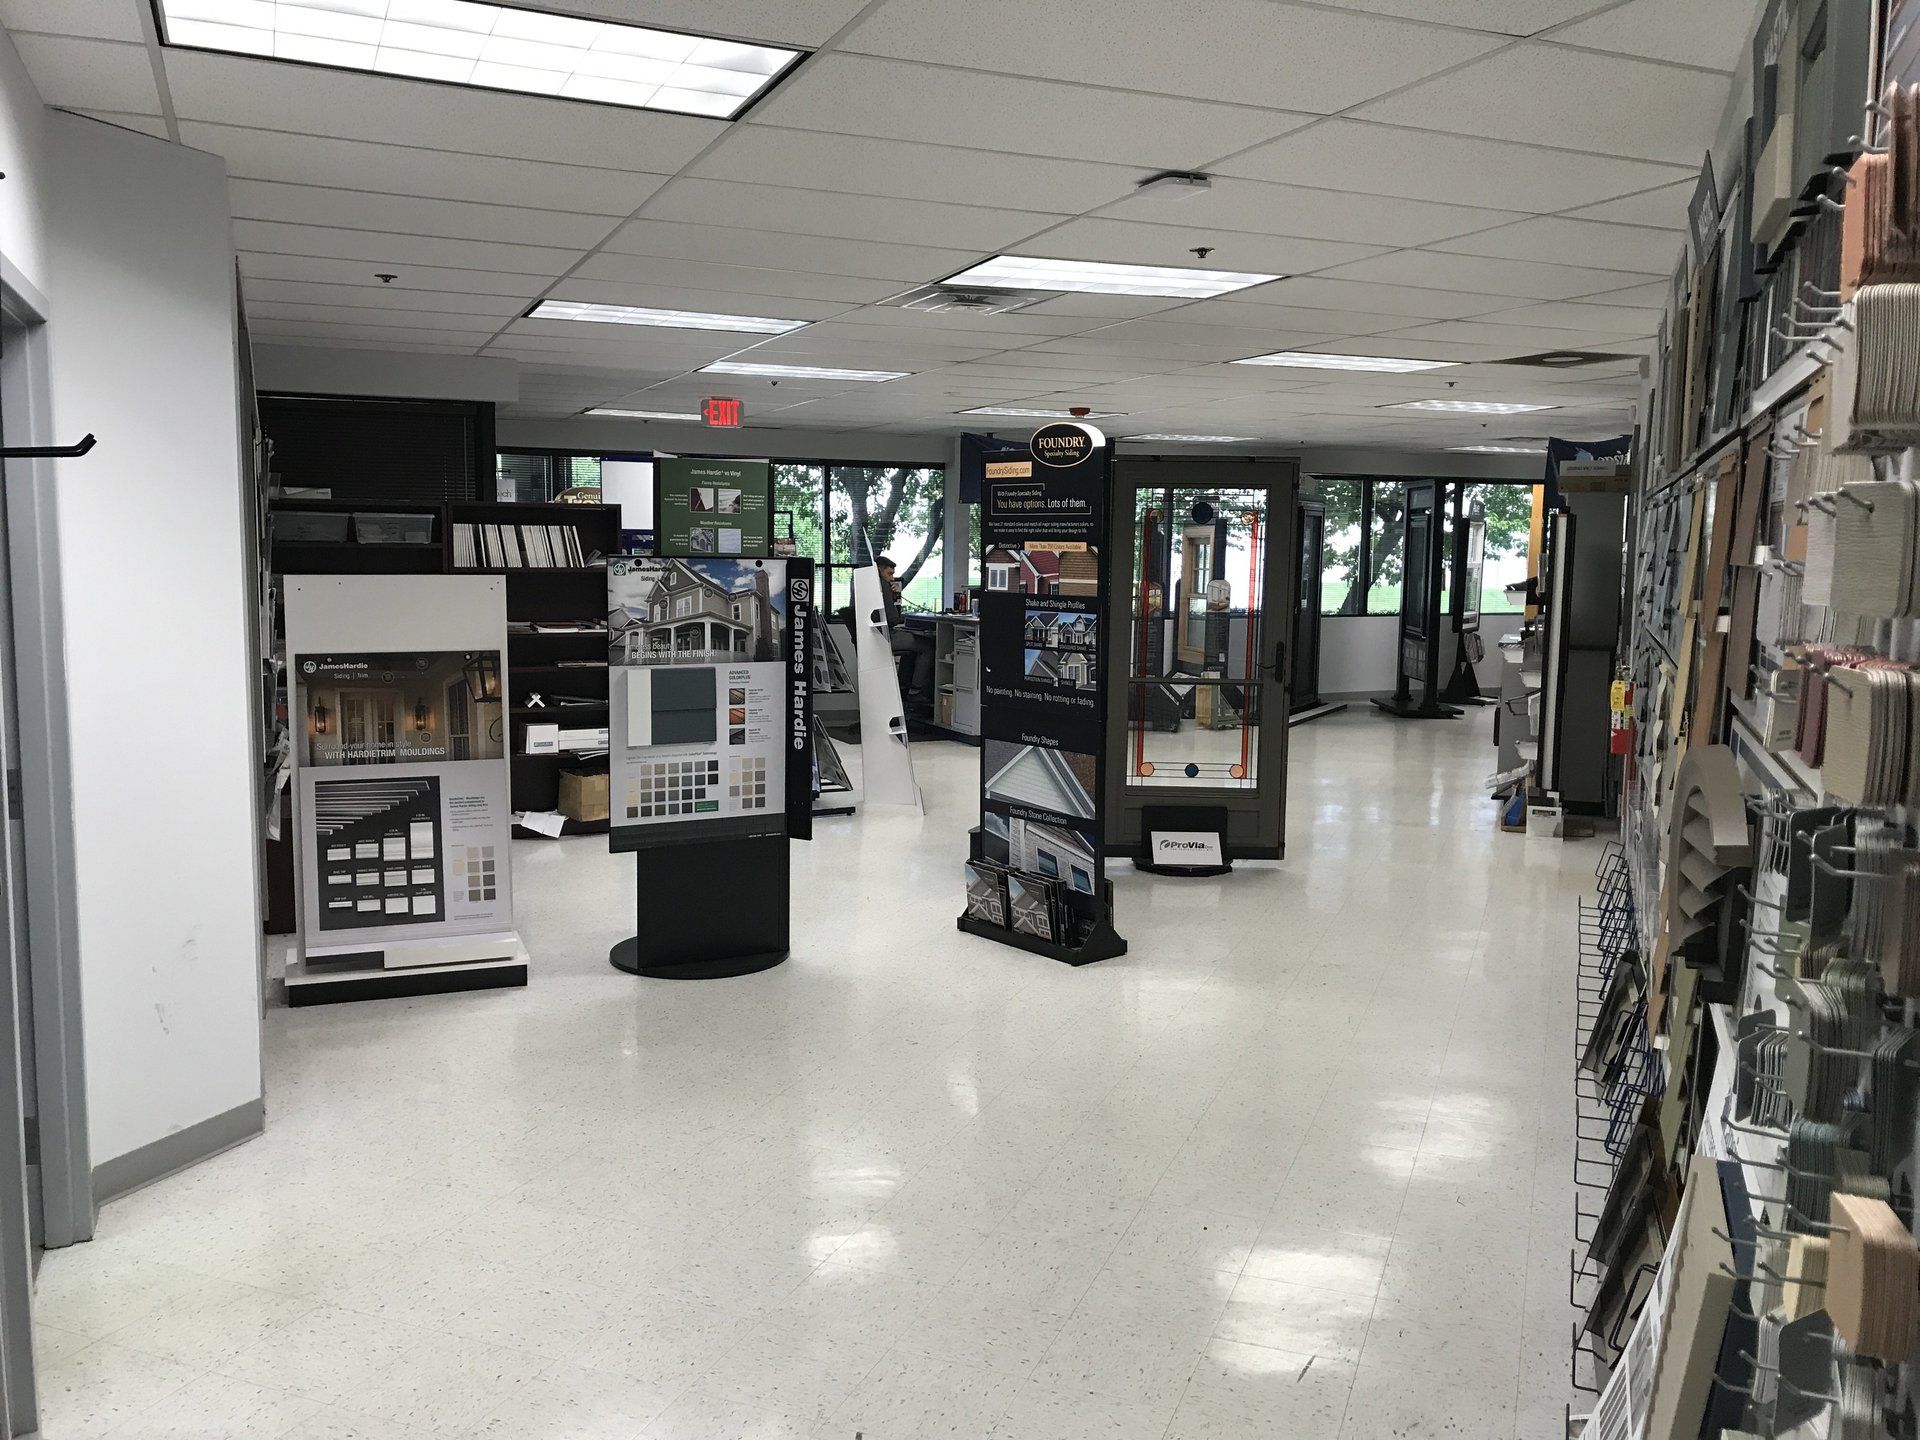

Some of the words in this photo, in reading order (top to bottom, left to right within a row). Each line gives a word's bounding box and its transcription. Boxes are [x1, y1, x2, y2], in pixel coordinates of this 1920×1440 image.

[709, 400, 739, 425] EXIT
[1038, 436, 1085, 448] FOUNDRY
[1044, 450, 1064, 458] Specialty
[1065, 450, 1079, 458] Siding
[987, 466, 1030, 476] FoundrySiding.com
[997, 499, 1007, 508] You
[1009, 499, 1022, 508] have
[1023, 499, 1046, 510] options.
[1048, 499, 1060, 508] Lots
[1062, 498, 1069, 508] of
[1070, 498, 1087, 508] them.
[1025, 599, 1039, 607] Shake
[1050, 600, 1067, 609] Shingle
[1068, 600, 1086, 609] Profiles
[794, 605, 806, 674] James
[631, 651, 656, 659] BEGINS
[678, 650, 690, 658] THE
[994, 687, 1013, 697] painting.
[1023, 691, 1043, 701] staining.
[1044, 693, 1052, 701] No
[1053, 695, 1069, 705] rotting
[1077, 696, 1095, 708] fading.
[794, 681, 807, 750] Hardie
[1021, 733, 1040, 744] Foundry
[1041, 736, 1059, 746] Shapes
[316, 743, 349, 751] Surround
[395, 741, 412, 749] style
[324, 751, 345, 760] WITH
[347, 749, 396, 758] HARDIETRIM
[400, 747, 445, 756] MOULDINGS
[1009, 806, 1027, 818] Foundry
[1028, 810, 1042, 819] Stone
[1043, 812, 1067, 824] Collection
